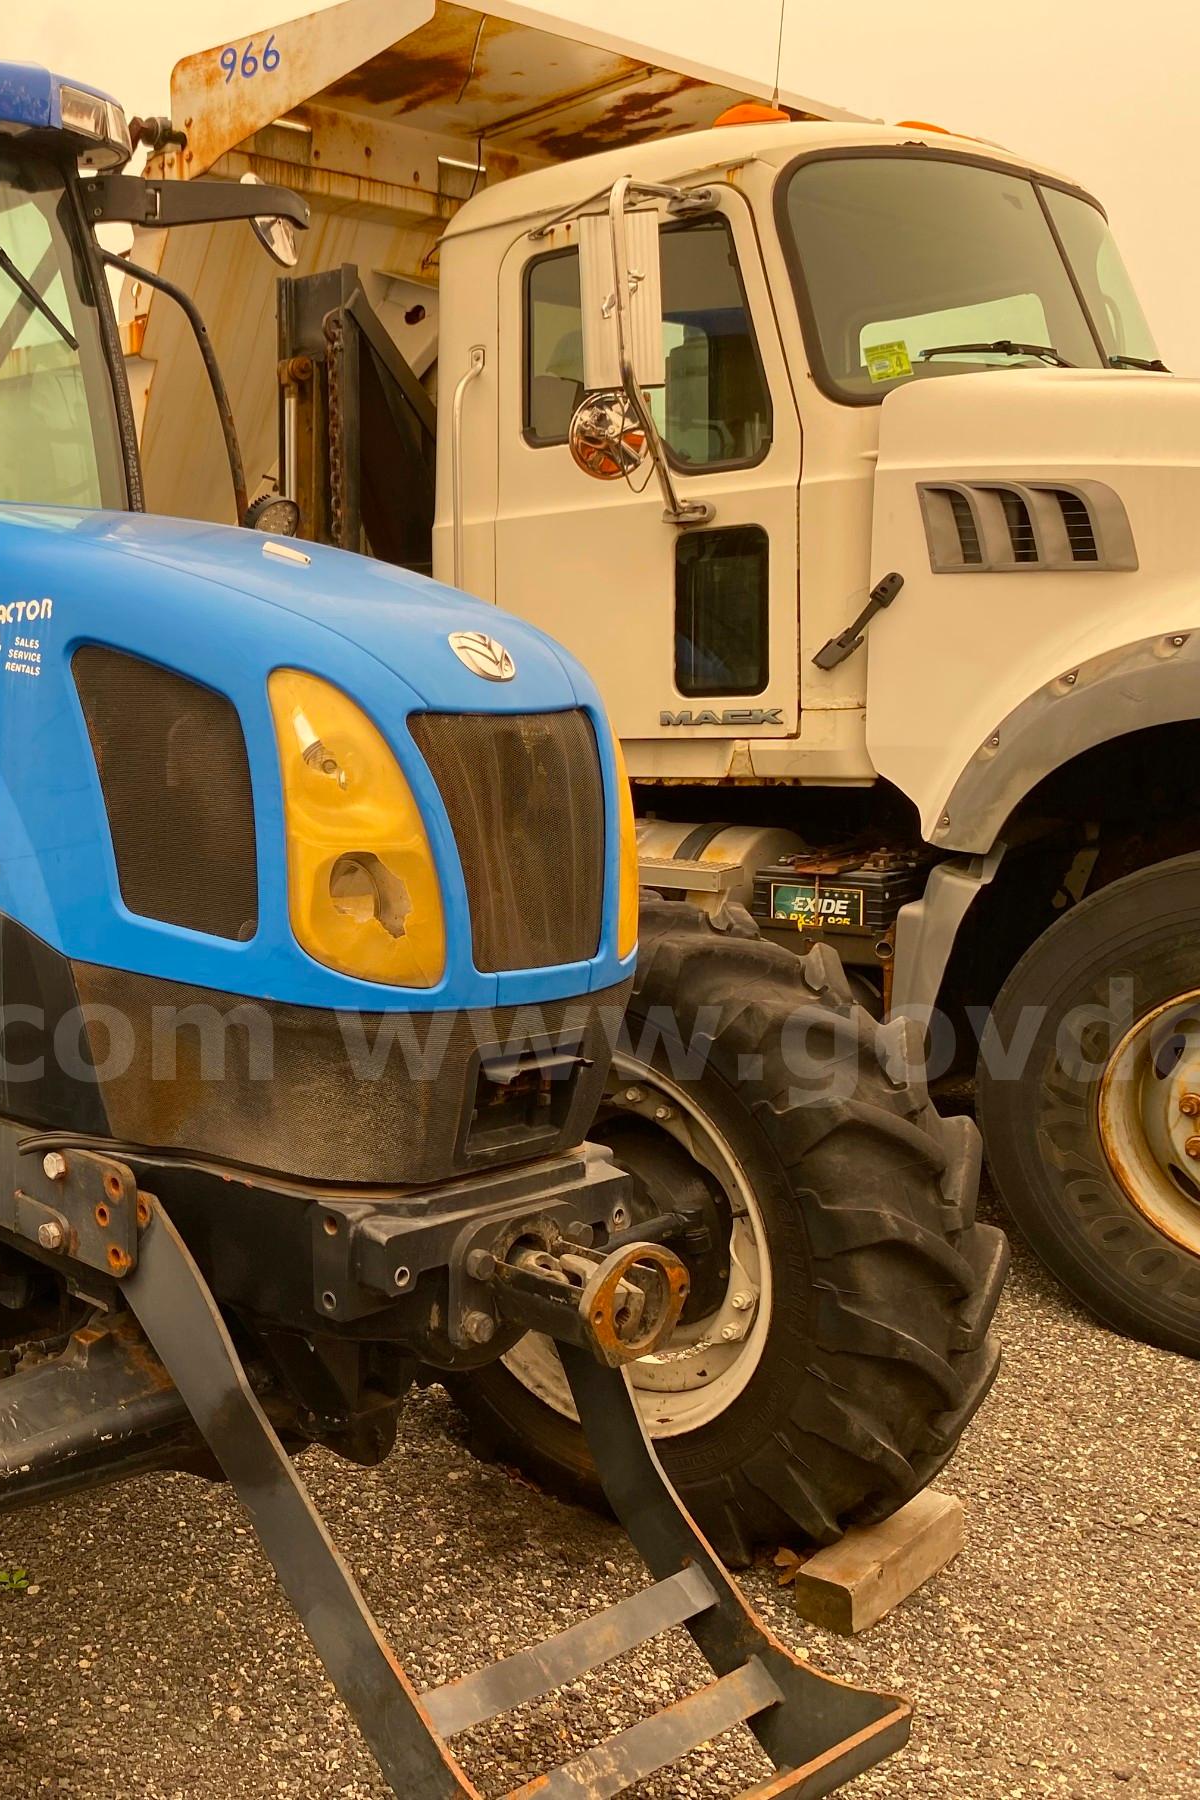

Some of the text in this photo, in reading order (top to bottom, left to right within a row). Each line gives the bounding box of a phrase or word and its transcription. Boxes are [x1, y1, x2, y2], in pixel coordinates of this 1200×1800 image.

[220, 33, 280, 85] 966
[14, 636, 40, 649] SALES
[7, 649, 42, 663] SERVICE
[5, 662, 41, 676] RENTALS
[659, 709, 784, 726] MACK
[792, 896, 852, 916] EXIDE
